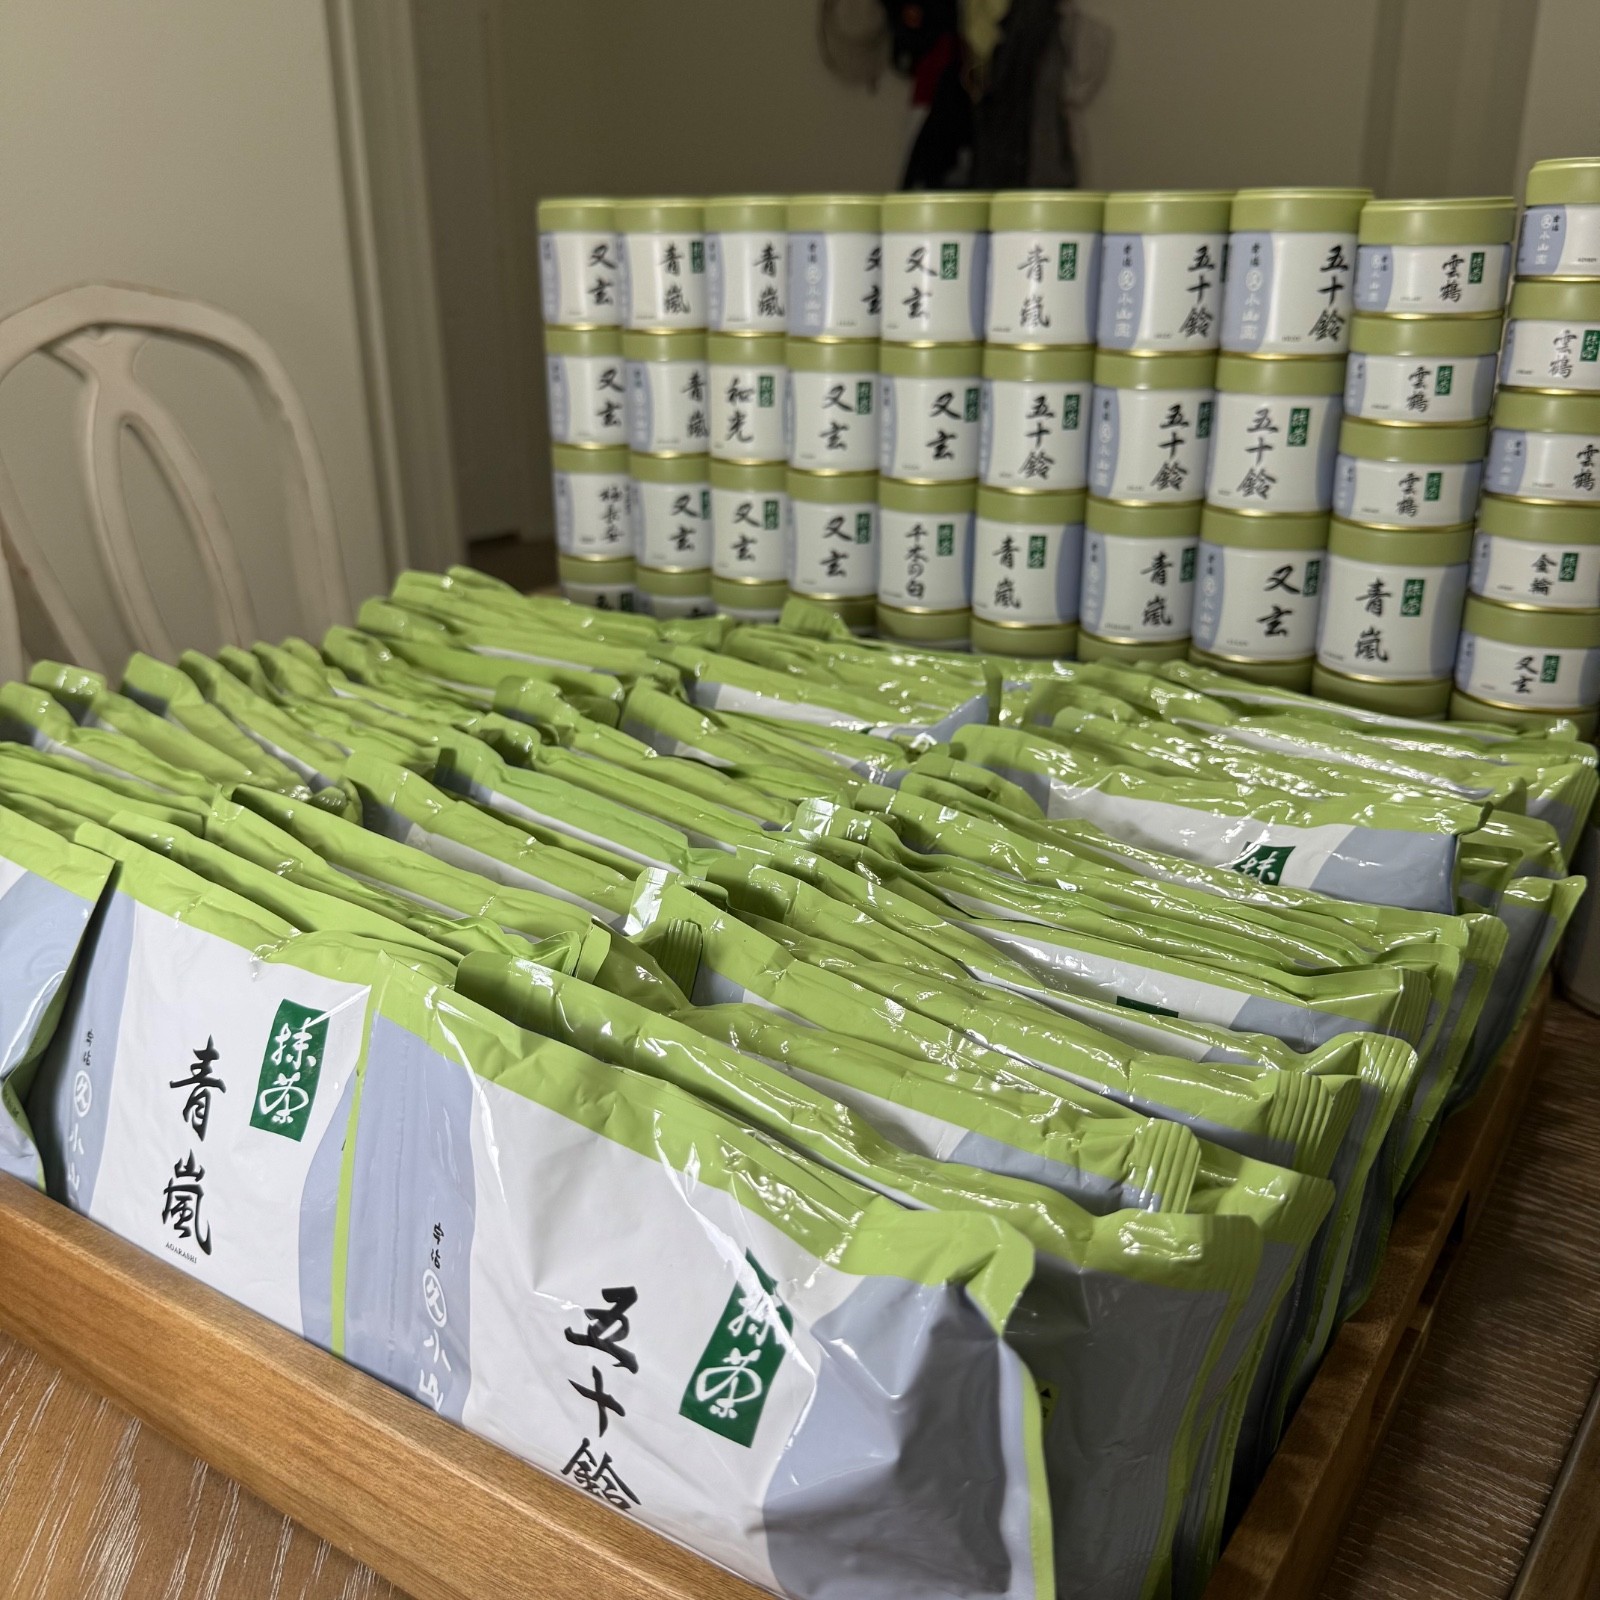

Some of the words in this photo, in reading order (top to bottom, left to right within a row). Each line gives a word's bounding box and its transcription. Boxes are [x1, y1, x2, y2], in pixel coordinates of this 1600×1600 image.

[588, 244, 617, 306] 又玄
[659, 243, 690, 314] 青嵐
[753, 243, 786, 317] 青嵐
[902, 246, 938, 320] 又玄
[1017, 244, 1051, 328] 青嵐
[1179, 244, 1215, 338] 五十鈴
[1308, 244, 1349, 342] 五十鈴
[1438, 253, 1465, 303] 雲鶴
[1406, 365, 1432, 413] 雲鶴
[1547, 329, 1578, 379] 雲鶴
[597, 368, 625, 428] 又玄
[820, 383, 853, 450] 又玄
[926, 391, 962, 460] 又玄
[1018, 394, 1055, 481] 五十鈴
[1150, 403, 1190, 492] 五十鈴
[1236, 407, 1279, 500] 五十鈴
[1572, 443, 1600, 492] 雲鶴
[670, 493, 700, 552] 又玄
[731, 501, 761, 562] 又玄
[1396, 472, 1421, 518] 雲鶴
[820, 515, 853, 579] 又玄
[993, 535, 1021, 609] 青嵐
[1140, 550, 1174, 627] 青嵐
[1257, 563, 1301, 638] 又玄
[1356, 577, 1392, 664] 青嵐
[1512, 655, 1539, 694] 又玄
[258, 1016, 318, 1125] 抹茶
[162, 1034, 226, 1256] 青嵐
[562, 1286, 642, 1510] 五十鈴
